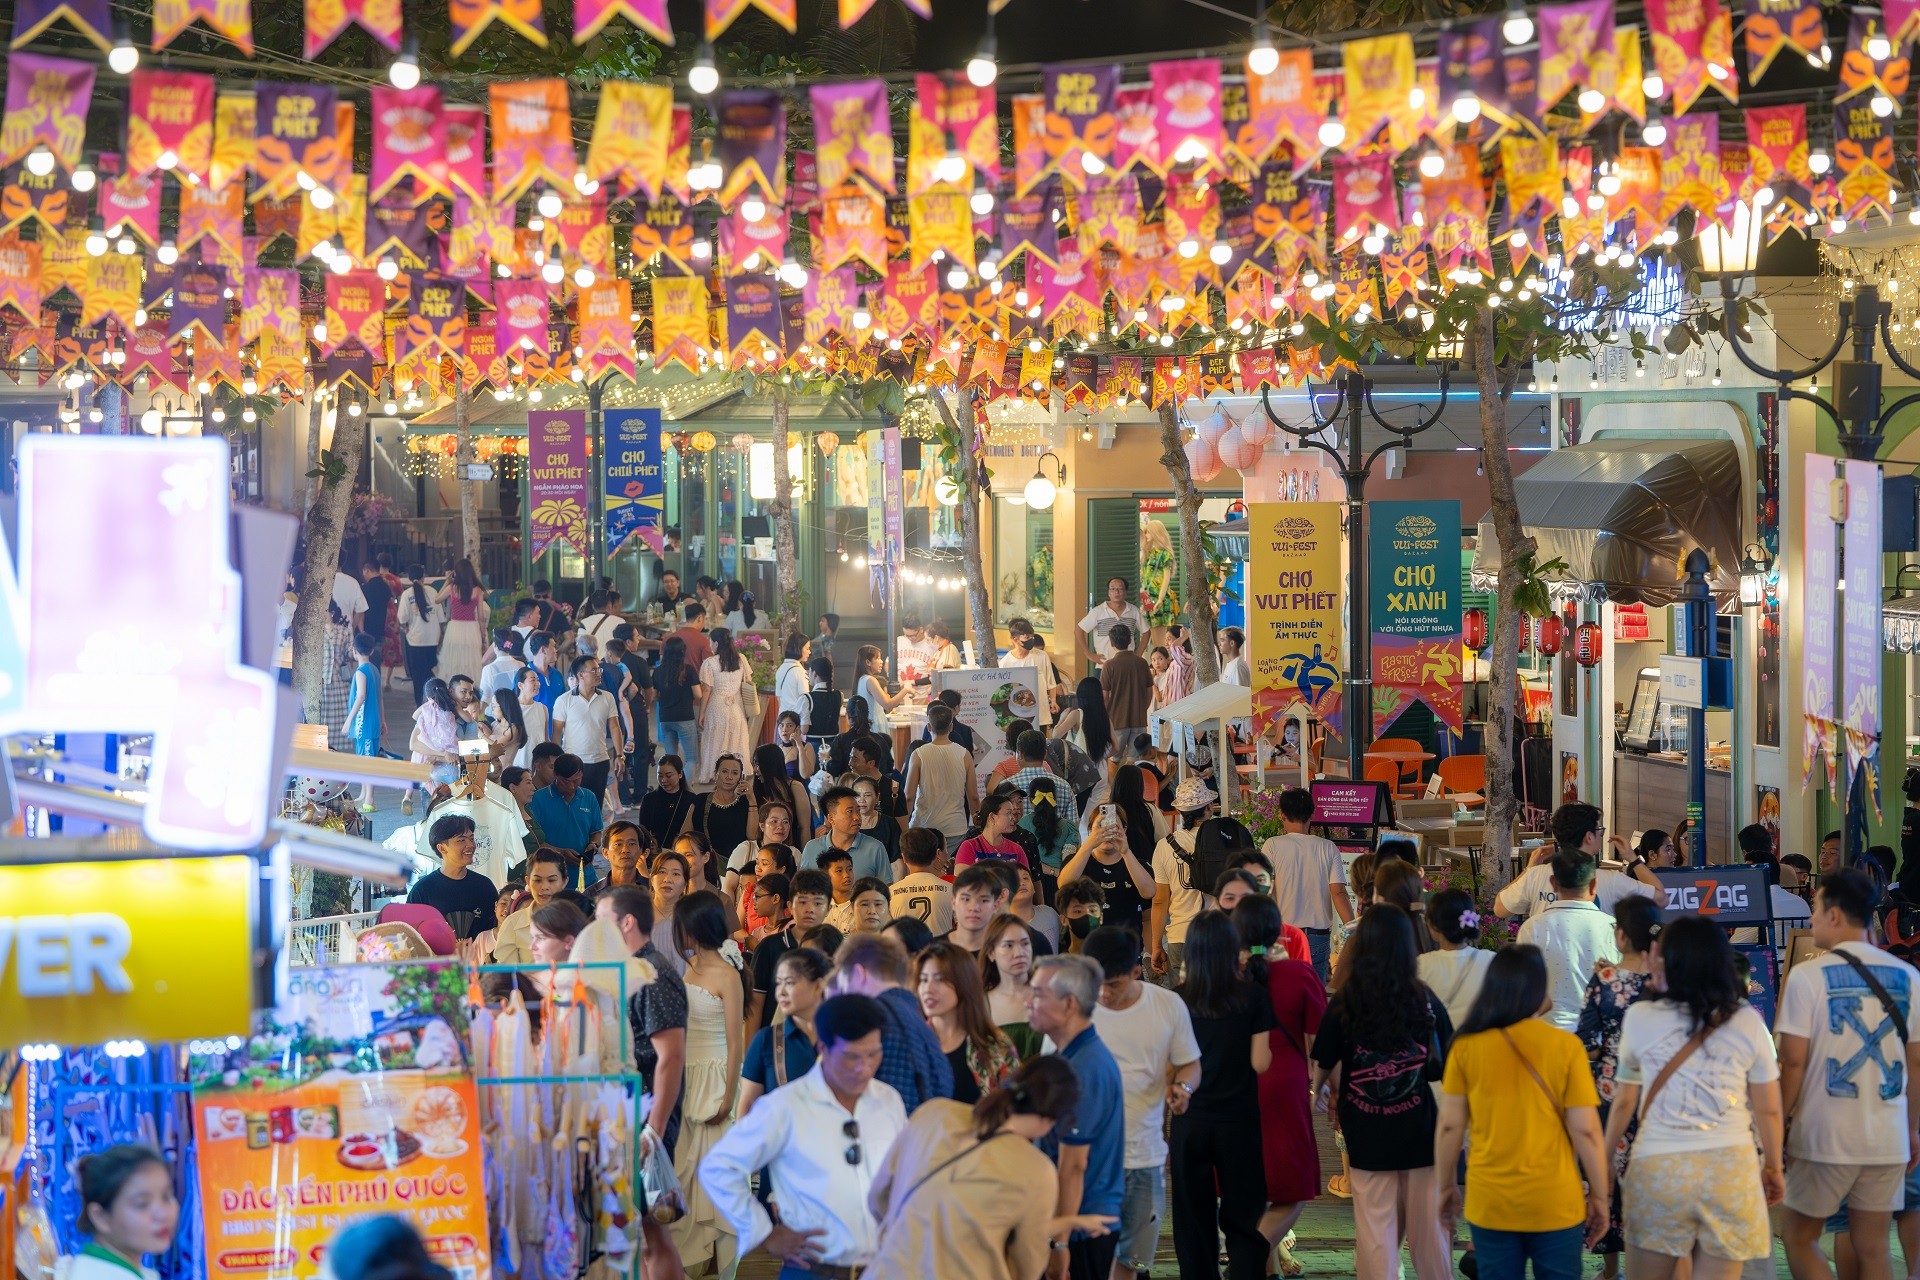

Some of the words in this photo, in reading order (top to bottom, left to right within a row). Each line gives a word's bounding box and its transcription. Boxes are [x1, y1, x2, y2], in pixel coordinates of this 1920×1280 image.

[546, 453, 569, 469] CHỢ
[621, 450, 646, 467] CHỢ
[533, 469, 556, 480] VUI
[608, 465, 634, 477] CHILL
[1154, 500, 1168, 508] nón
[1279, 569, 1313, 591] CHỢ
[1393, 564, 1436, 590] CHỢ
[1255, 594, 1288, 610] VUI
[1292, 590, 1337, 611] PHẾT
[1387, 590, 1447, 612] XANH
[1270, 619, 1298, 630] TRÌNH
[1380, 624, 1395, 633] VỚI
[1395, 622, 1413, 633] ỐNG
[1414, 624, 1430, 632] HÚT
[1431, 624, 1454, 633] NHỰA
[1395, 616, 1408, 625] NÓI
[1410, 616, 1439, 625] KHÔNG
[1291, 630, 1318, 640] THỰC
[909, 897, 932, 924] 2
[1382, 1095, 1422, 1115] WORLD
[394, 1166, 467, 1200] QUỐC
